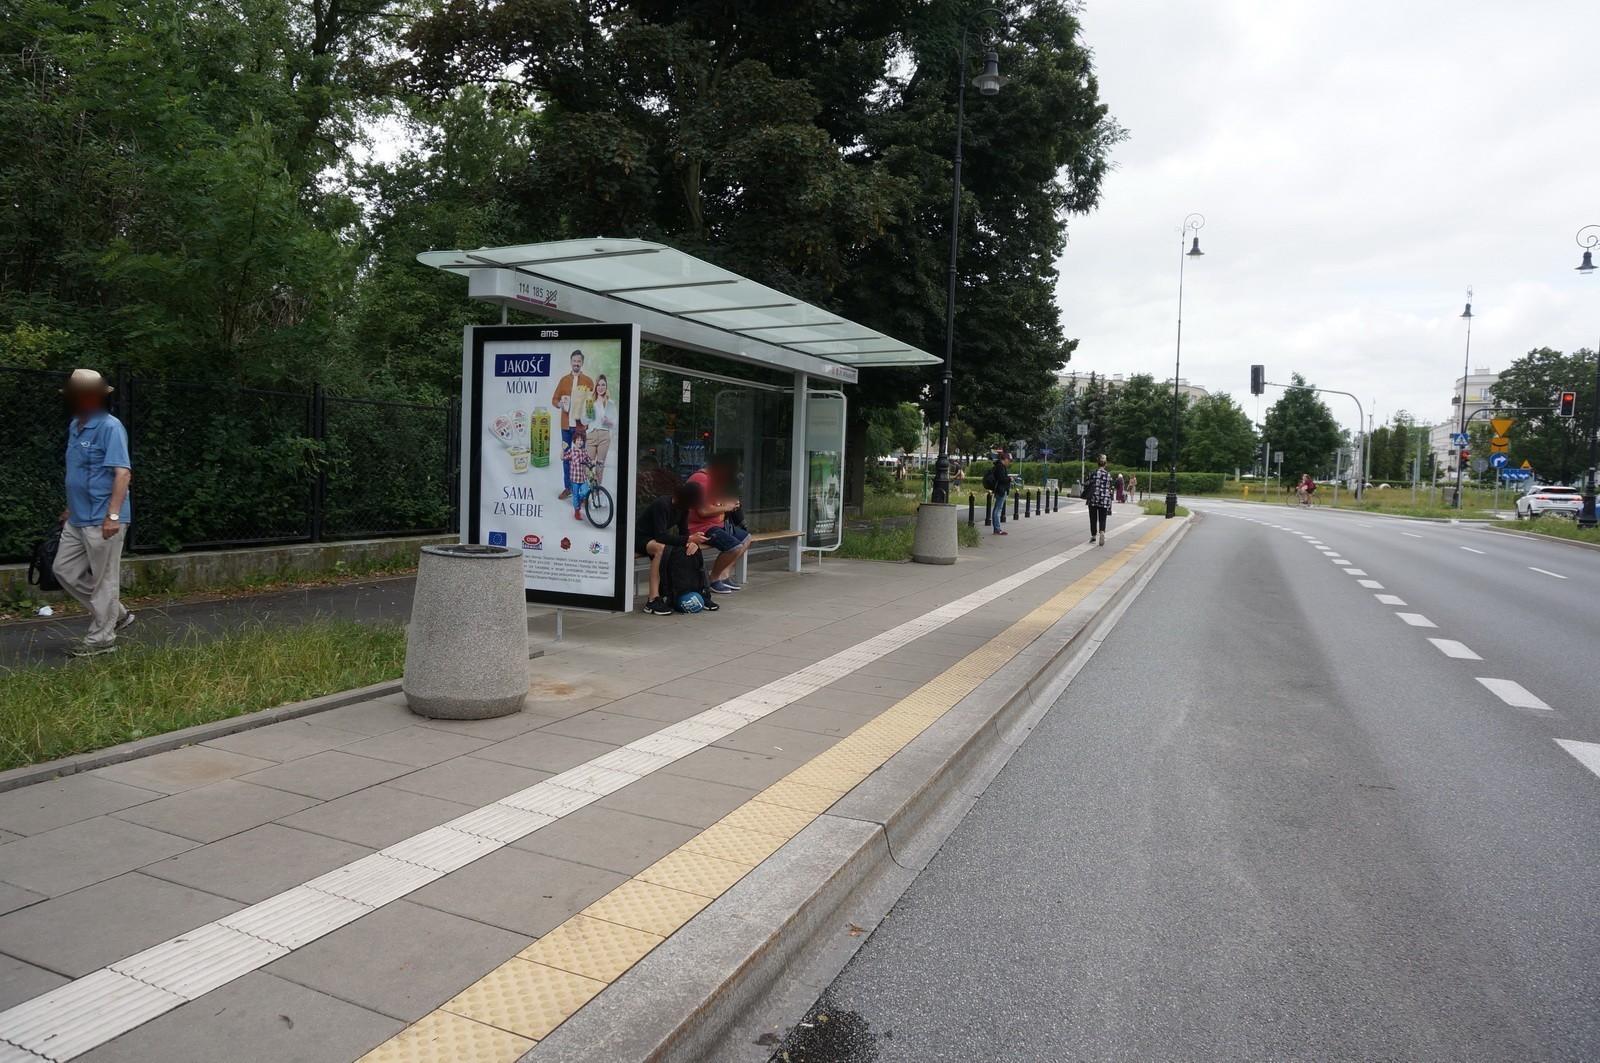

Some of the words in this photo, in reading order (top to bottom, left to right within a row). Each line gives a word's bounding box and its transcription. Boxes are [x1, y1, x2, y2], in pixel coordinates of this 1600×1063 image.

[519, 282, 530, 294] 114
[532, 286, 544, 298] 185
[540, 330, 559, 338] ams
[502, 356, 545, 373] JAKOŚĆ
[506, 377, 538, 394] MÓWI
[503, 486, 534, 500] SAMA
[493, 501, 507, 515] ZA
[509, 502, 545, 518] SIEBIE
